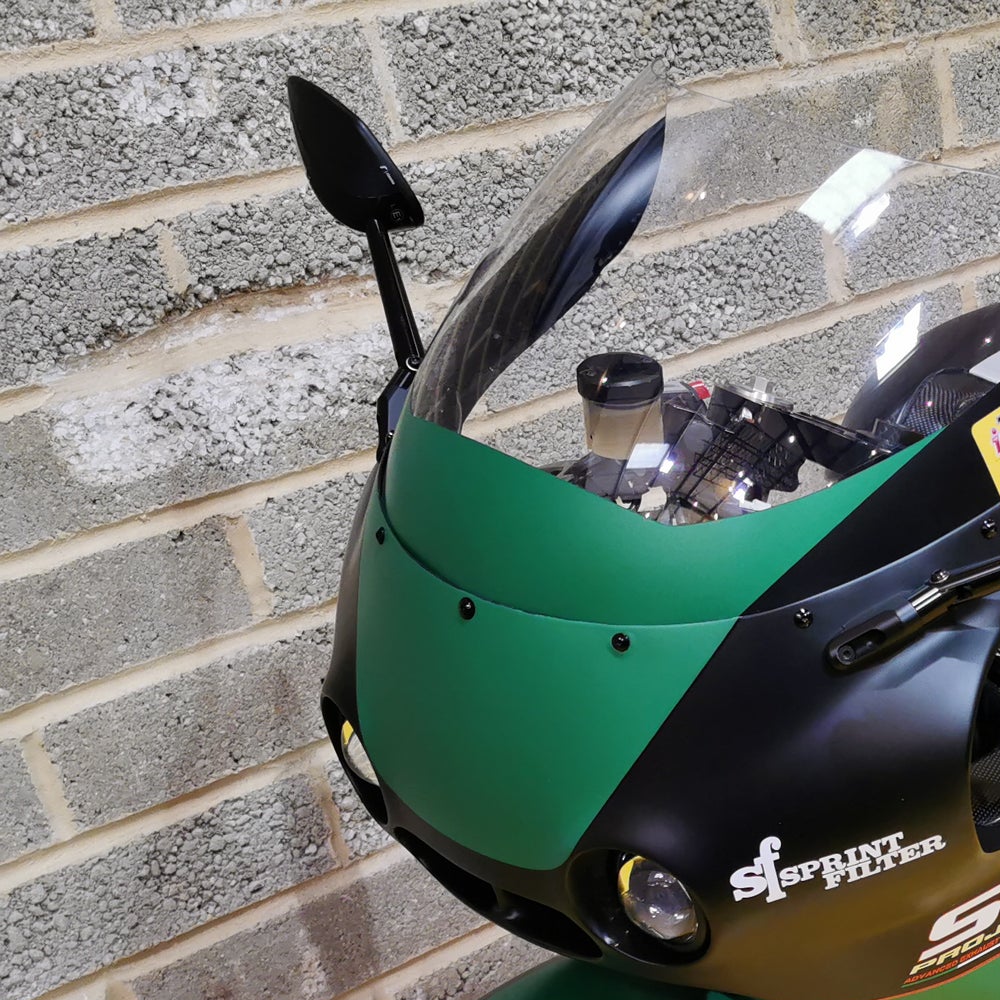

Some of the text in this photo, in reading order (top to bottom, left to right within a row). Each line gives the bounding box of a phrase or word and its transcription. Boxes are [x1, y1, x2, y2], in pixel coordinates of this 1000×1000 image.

[780, 831, 905, 889] SPRINT
[823, 834, 947, 891] FILTER
[903, 959, 959, 985] ADVANCED
[959, 936, 1000, 964] EXHAUST
